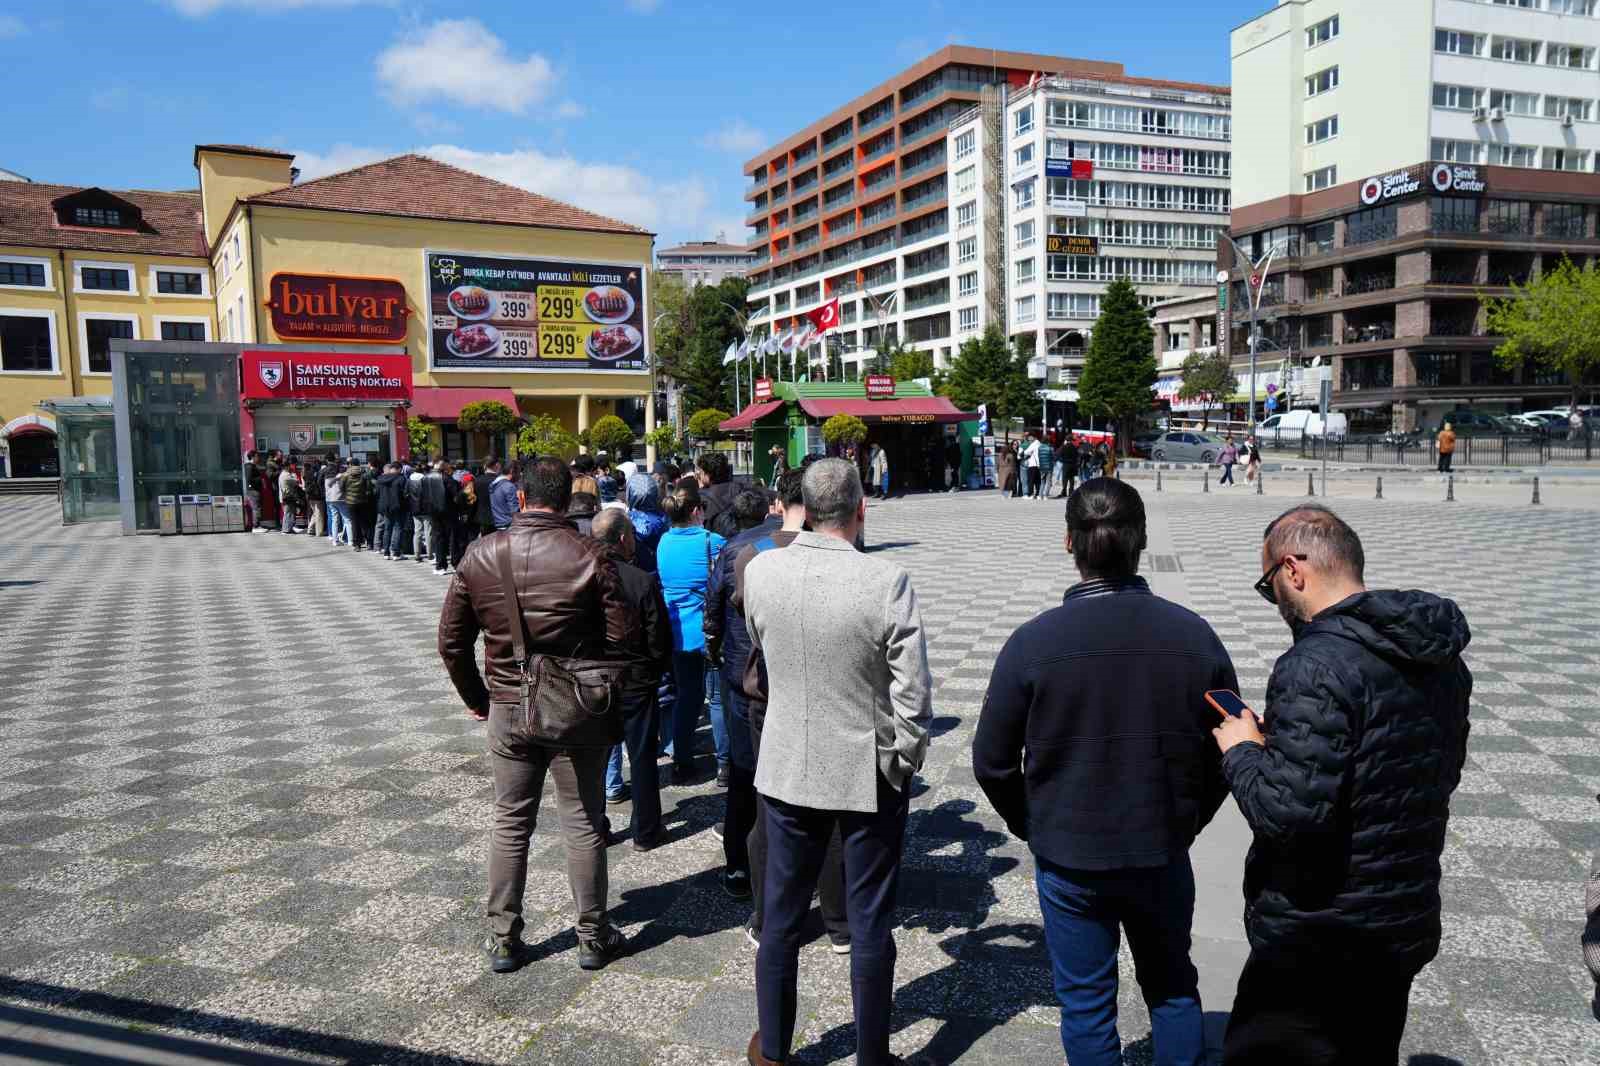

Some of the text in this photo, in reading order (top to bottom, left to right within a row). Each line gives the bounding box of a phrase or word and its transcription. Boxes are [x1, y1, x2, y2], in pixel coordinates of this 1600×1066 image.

[1383, 171, 1409, 187] Simit
[1454, 167, 1476, 180] Simit
[1383, 181, 1420, 198] Center
[1454, 178, 1485, 192] Center
[463, 267, 484, 277] BURSA
[485, 269, 505, 279] KEBAP
[538, 271, 571, 281] AVANTAJLI
[589, 273, 622, 283] LEZZETLER
[280, 280, 400, 321] bulvar
[296, 364, 380, 376] SAMSUNSPOR
[328, 378, 357, 389] SATIŞ
[360, 378, 402, 387] NOKTASI
